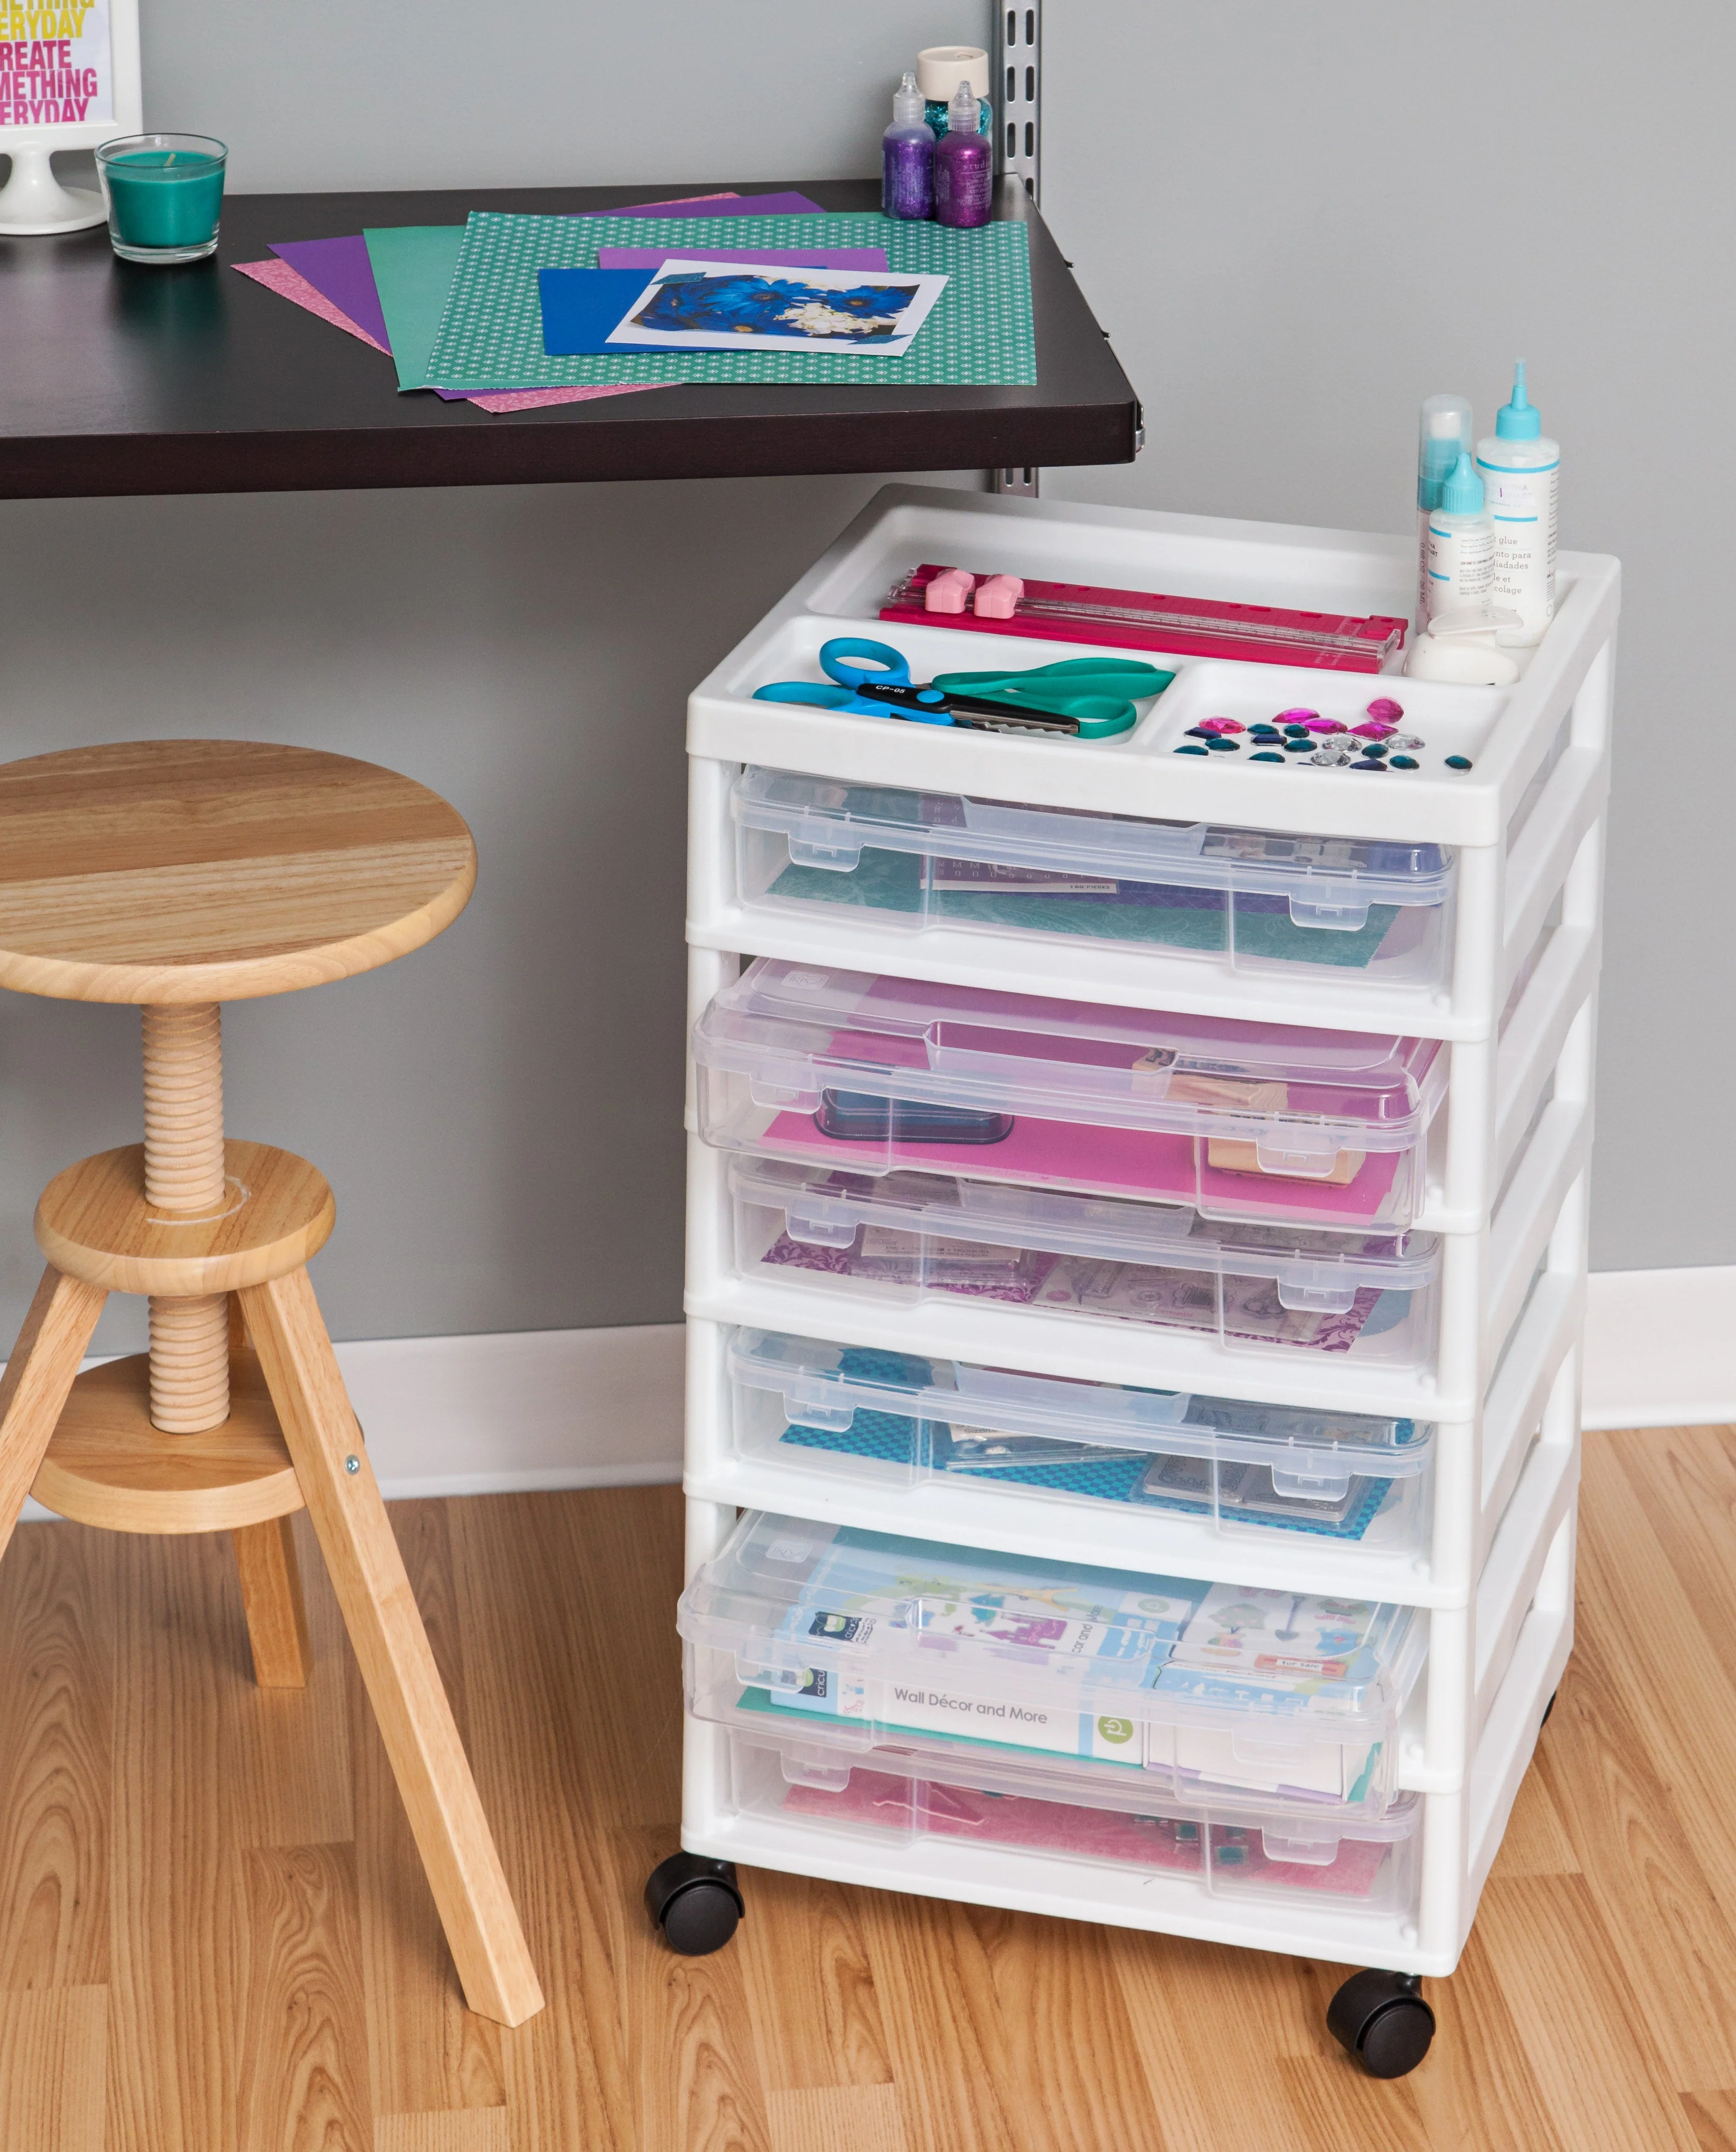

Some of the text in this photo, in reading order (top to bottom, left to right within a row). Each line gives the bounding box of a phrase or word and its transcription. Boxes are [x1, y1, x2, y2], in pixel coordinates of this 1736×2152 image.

[1499, 536, 1517, 545] glue
[1494, 585, 1522, 595] colage
[816, 1670, 825, 1696] cricu
[894, 1687, 1048, 1724] Wall Décor and More
